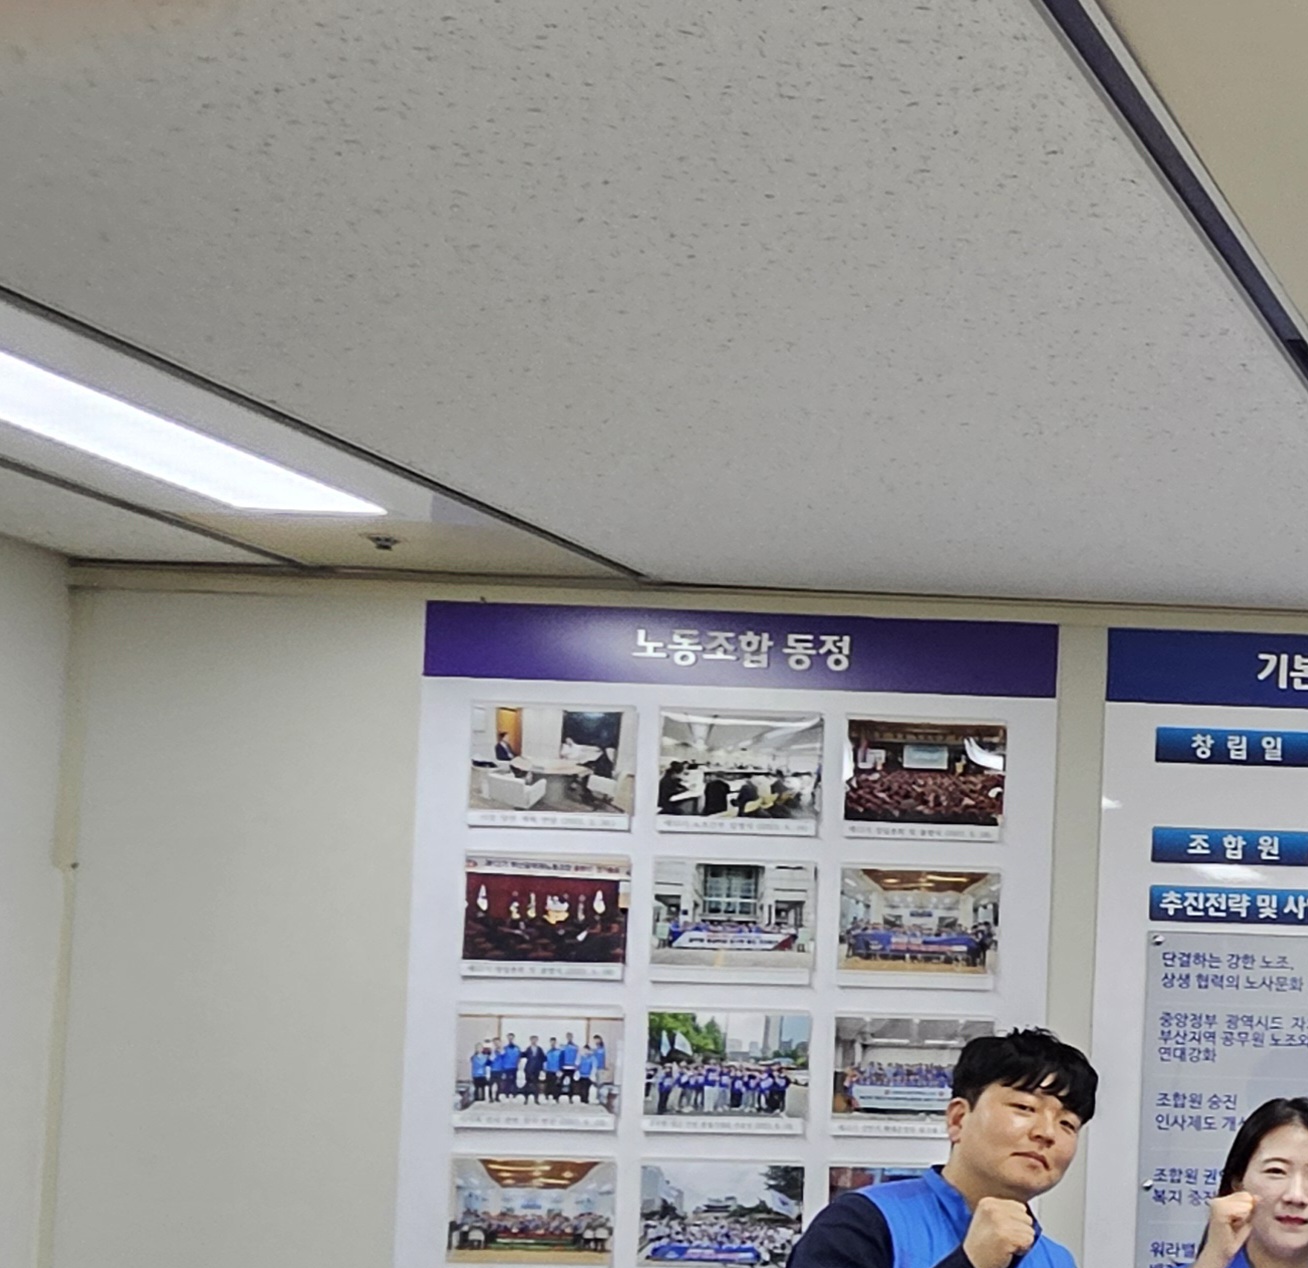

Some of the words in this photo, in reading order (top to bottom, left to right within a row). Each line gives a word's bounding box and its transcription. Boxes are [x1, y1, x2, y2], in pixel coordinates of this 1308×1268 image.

[632, 629, 774, 668] 노동조합
[782, 634, 852, 672] 동정
[1160, 890, 1251, 919] 추진전략
[1257, 892, 1277, 919] 및
[1161, 952, 1222, 969] 단결하는
[1227, 954, 1256, 970] 강한
[1161, 972, 1191, 990] 상생
[1195, 974, 1240, 991] 협력의
[1244, 976, 1304, 993] 노사문화
[1159, 1012, 1217, 1029] 중앙정부
[1158, 1031, 1217, 1046] 부산지역
[1222, 1032, 1265, 1048] 공무원
[1158, 1047, 1217, 1063] 연대강화
[1156, 1092, 1203, 1110] 조합원
[1155, 1113, 1218, 1131] 인사제도
[1153, 1167, 1198, 1185] 조합원
[1152, 1189, 1182, 1206] 복지
